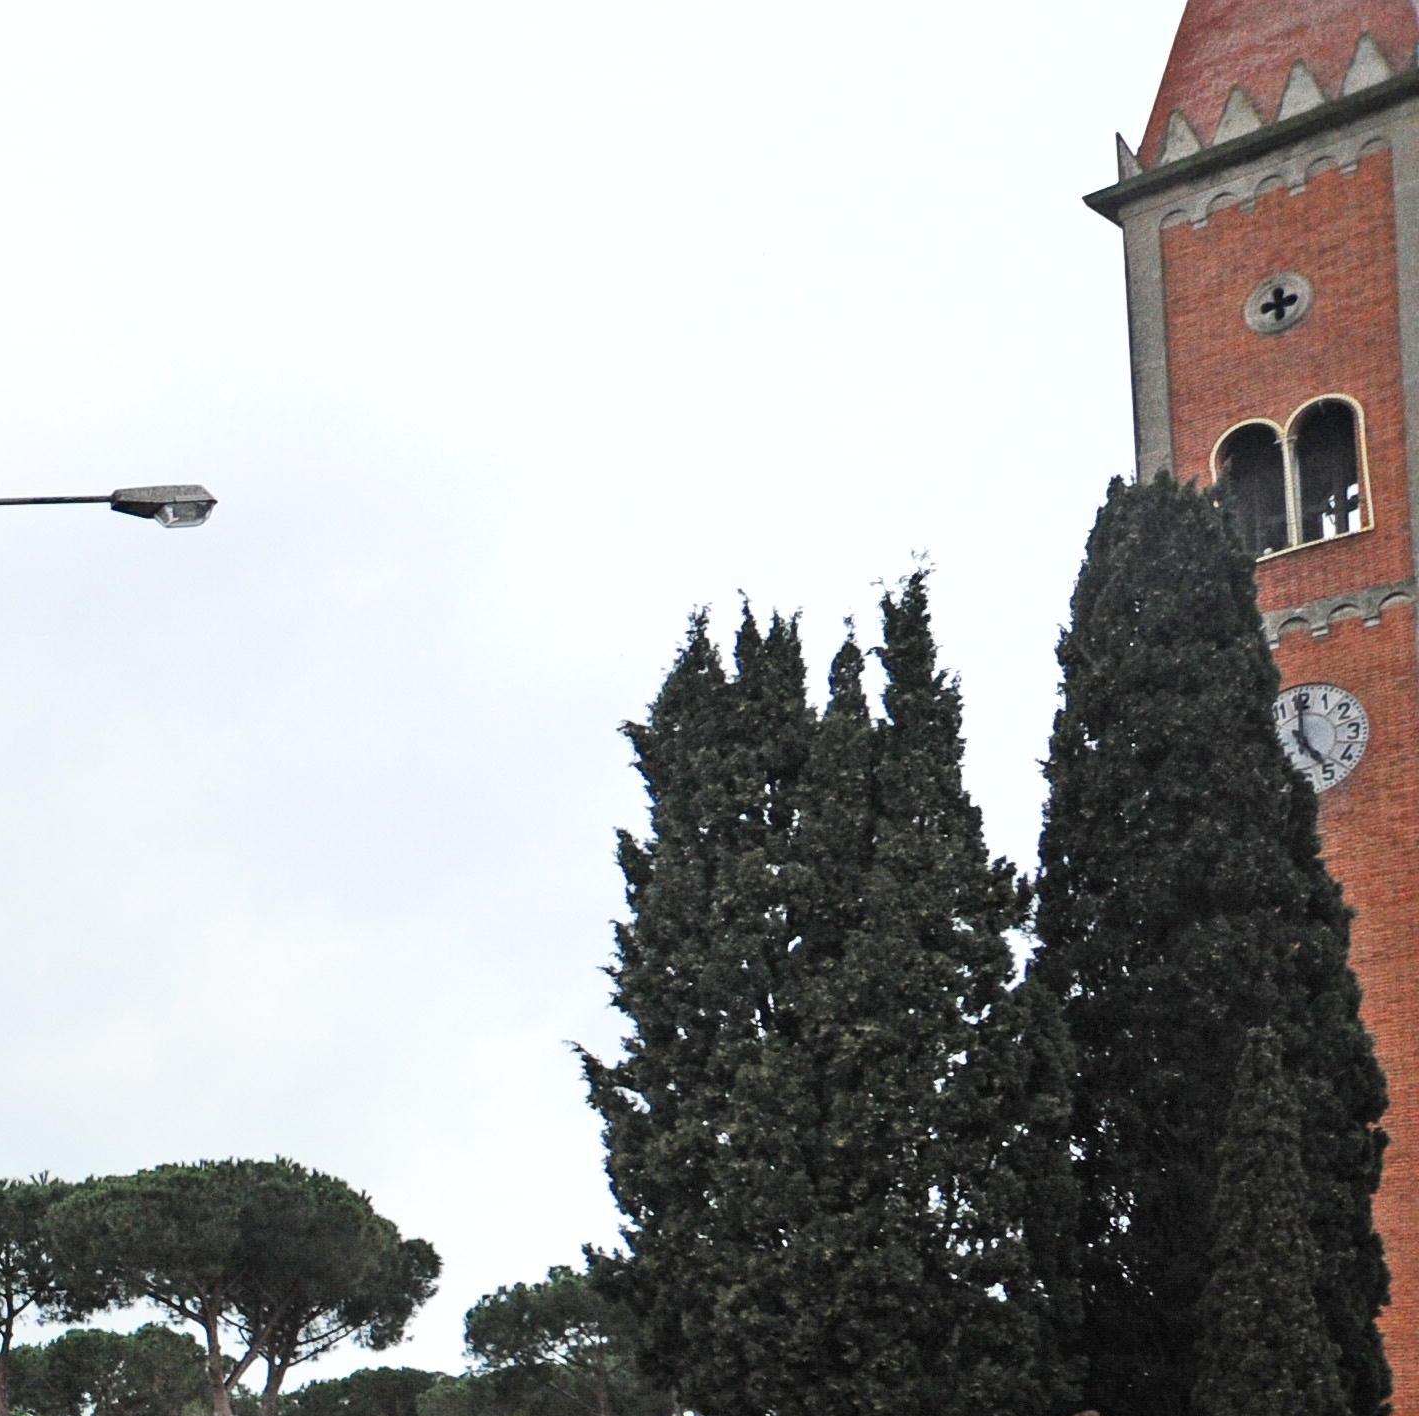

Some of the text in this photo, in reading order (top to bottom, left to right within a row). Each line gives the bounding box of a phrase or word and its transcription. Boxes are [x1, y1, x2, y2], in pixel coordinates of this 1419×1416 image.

[1321, 693, 1329, 710] 1
[1337, 702, 1351, 720] 2
[1347, 722, 1360, 740] 3
[1340, 744, 1353, 762] 4
[1322, 763, 1335, 780] 5
